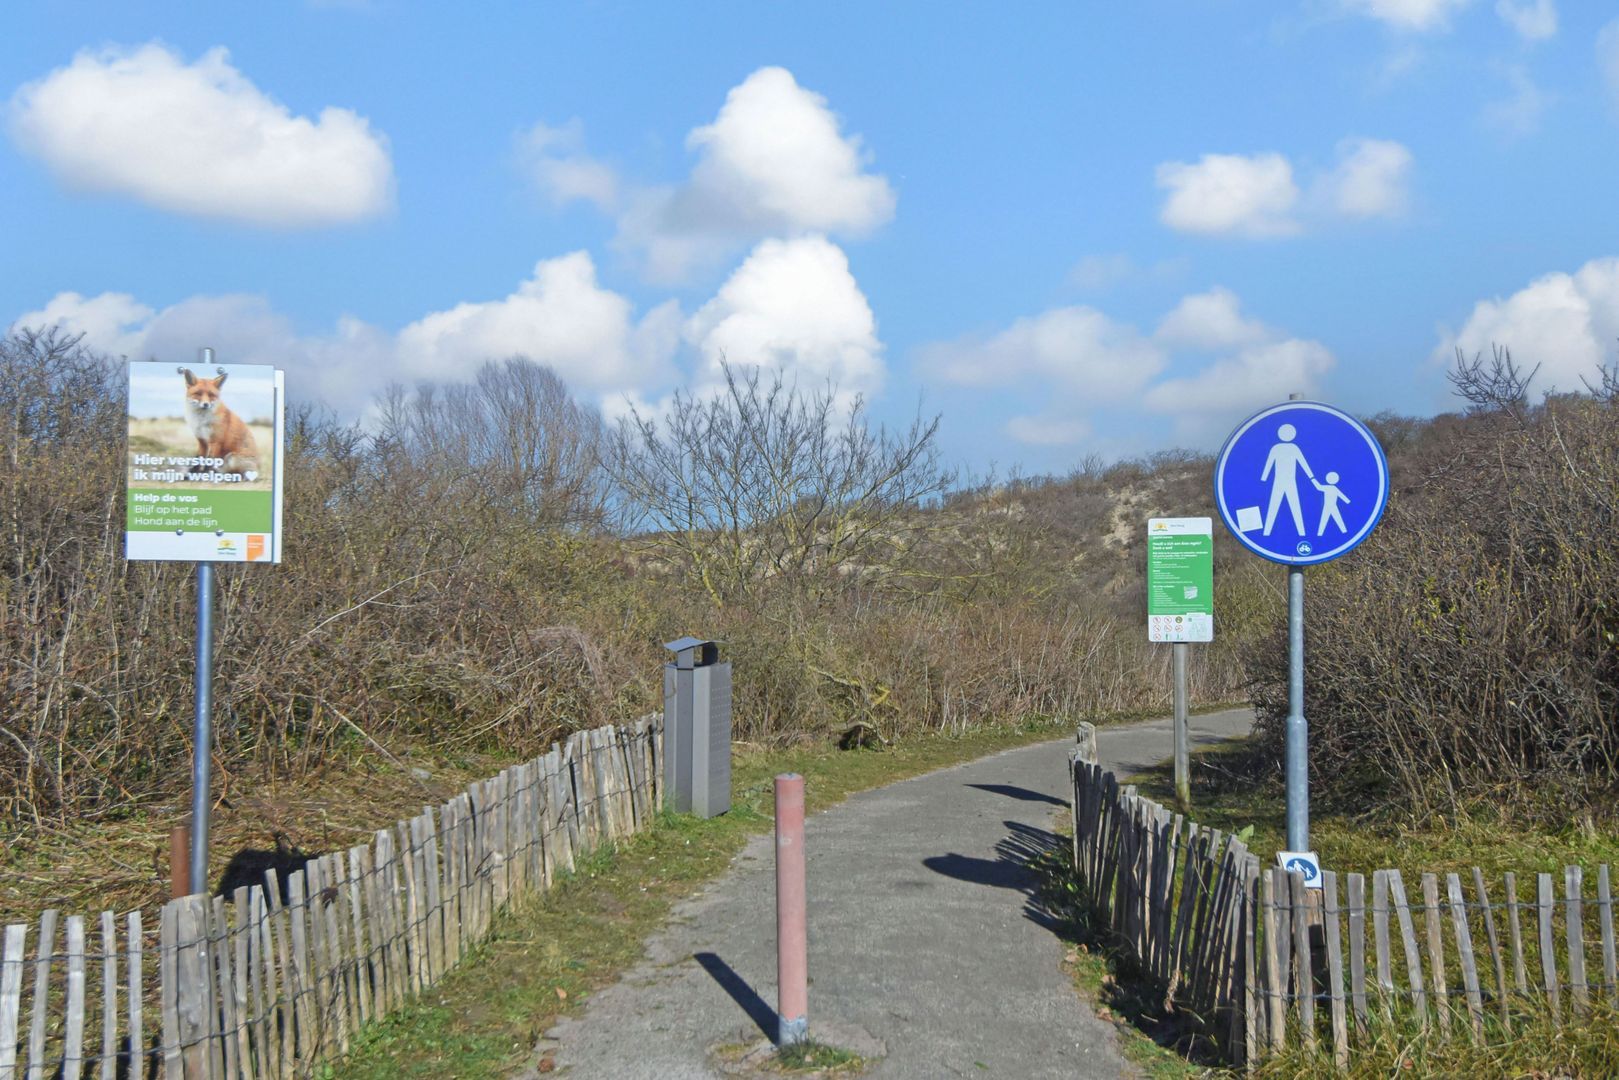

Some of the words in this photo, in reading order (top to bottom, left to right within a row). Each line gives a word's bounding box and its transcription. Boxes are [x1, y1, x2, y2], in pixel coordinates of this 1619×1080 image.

[134, 454, 164, 466] Hier
[168, 456, 224, 469] verstop
[133, 469, 147, 480] ik
[151, 469, 185, 483] mijn
[188, 470, 242, 483] welpen
[134, 493, 160, 503] Help
[162, 493, 176, 502] de
[179, 495, 198, 503] vos
[135, 504, 154, 515] Blijf
[157, 507, 170, 516] op
[173, 505, 189, 514] het
[192, 506, 212, 515] pad
[135, 517, 162, 526] Hond
[165, 518, 184, 526] aan
[186, 517, 201, 526] de
[202, 517, 217, 528] lijn
